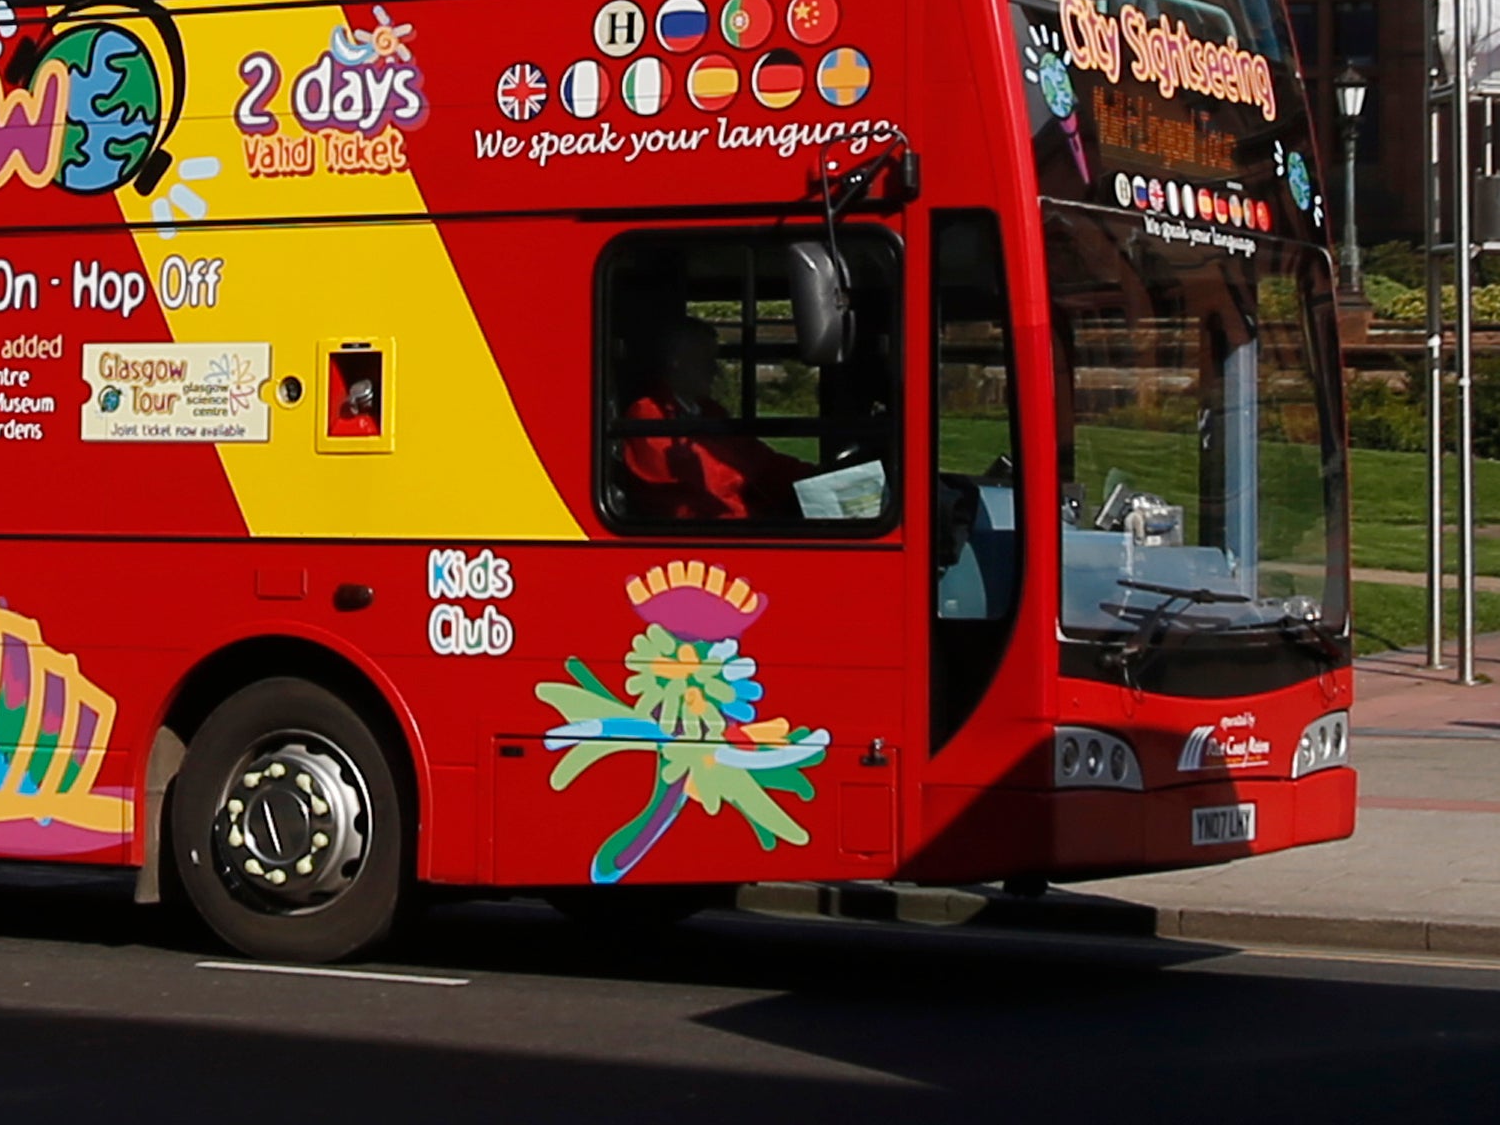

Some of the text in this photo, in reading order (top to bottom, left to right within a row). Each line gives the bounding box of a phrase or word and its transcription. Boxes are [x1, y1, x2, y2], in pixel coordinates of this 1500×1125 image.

[608, 11, 636, 45] H
[1121, 4, 1276, 122] Sightseeing
[236, 53, 423, 132] 2 days
[244, 129, 406, 175] Valid Ticket
[475, 117, 898, 166] We speak your language
[1161, 220, 1190, 244] speak
[1211, 226, 1257, 258] language
[72, 260, 146, 318] Hop
[160, 255, 224, 310] Off
[1, 334, 63, 359] added
[99, 352, 188, 386] Glasgow
[130, 384, 181, 416] Tour
[183, 382, 228, 394] glasgow
[186, 395, 228, 405] science
[111, 423, 246, 437] Joint ticket now available
[193, 407, 228, 417] centre
[428, 549, 513, 599] Kids
[428, 603, 513, 655] Club
